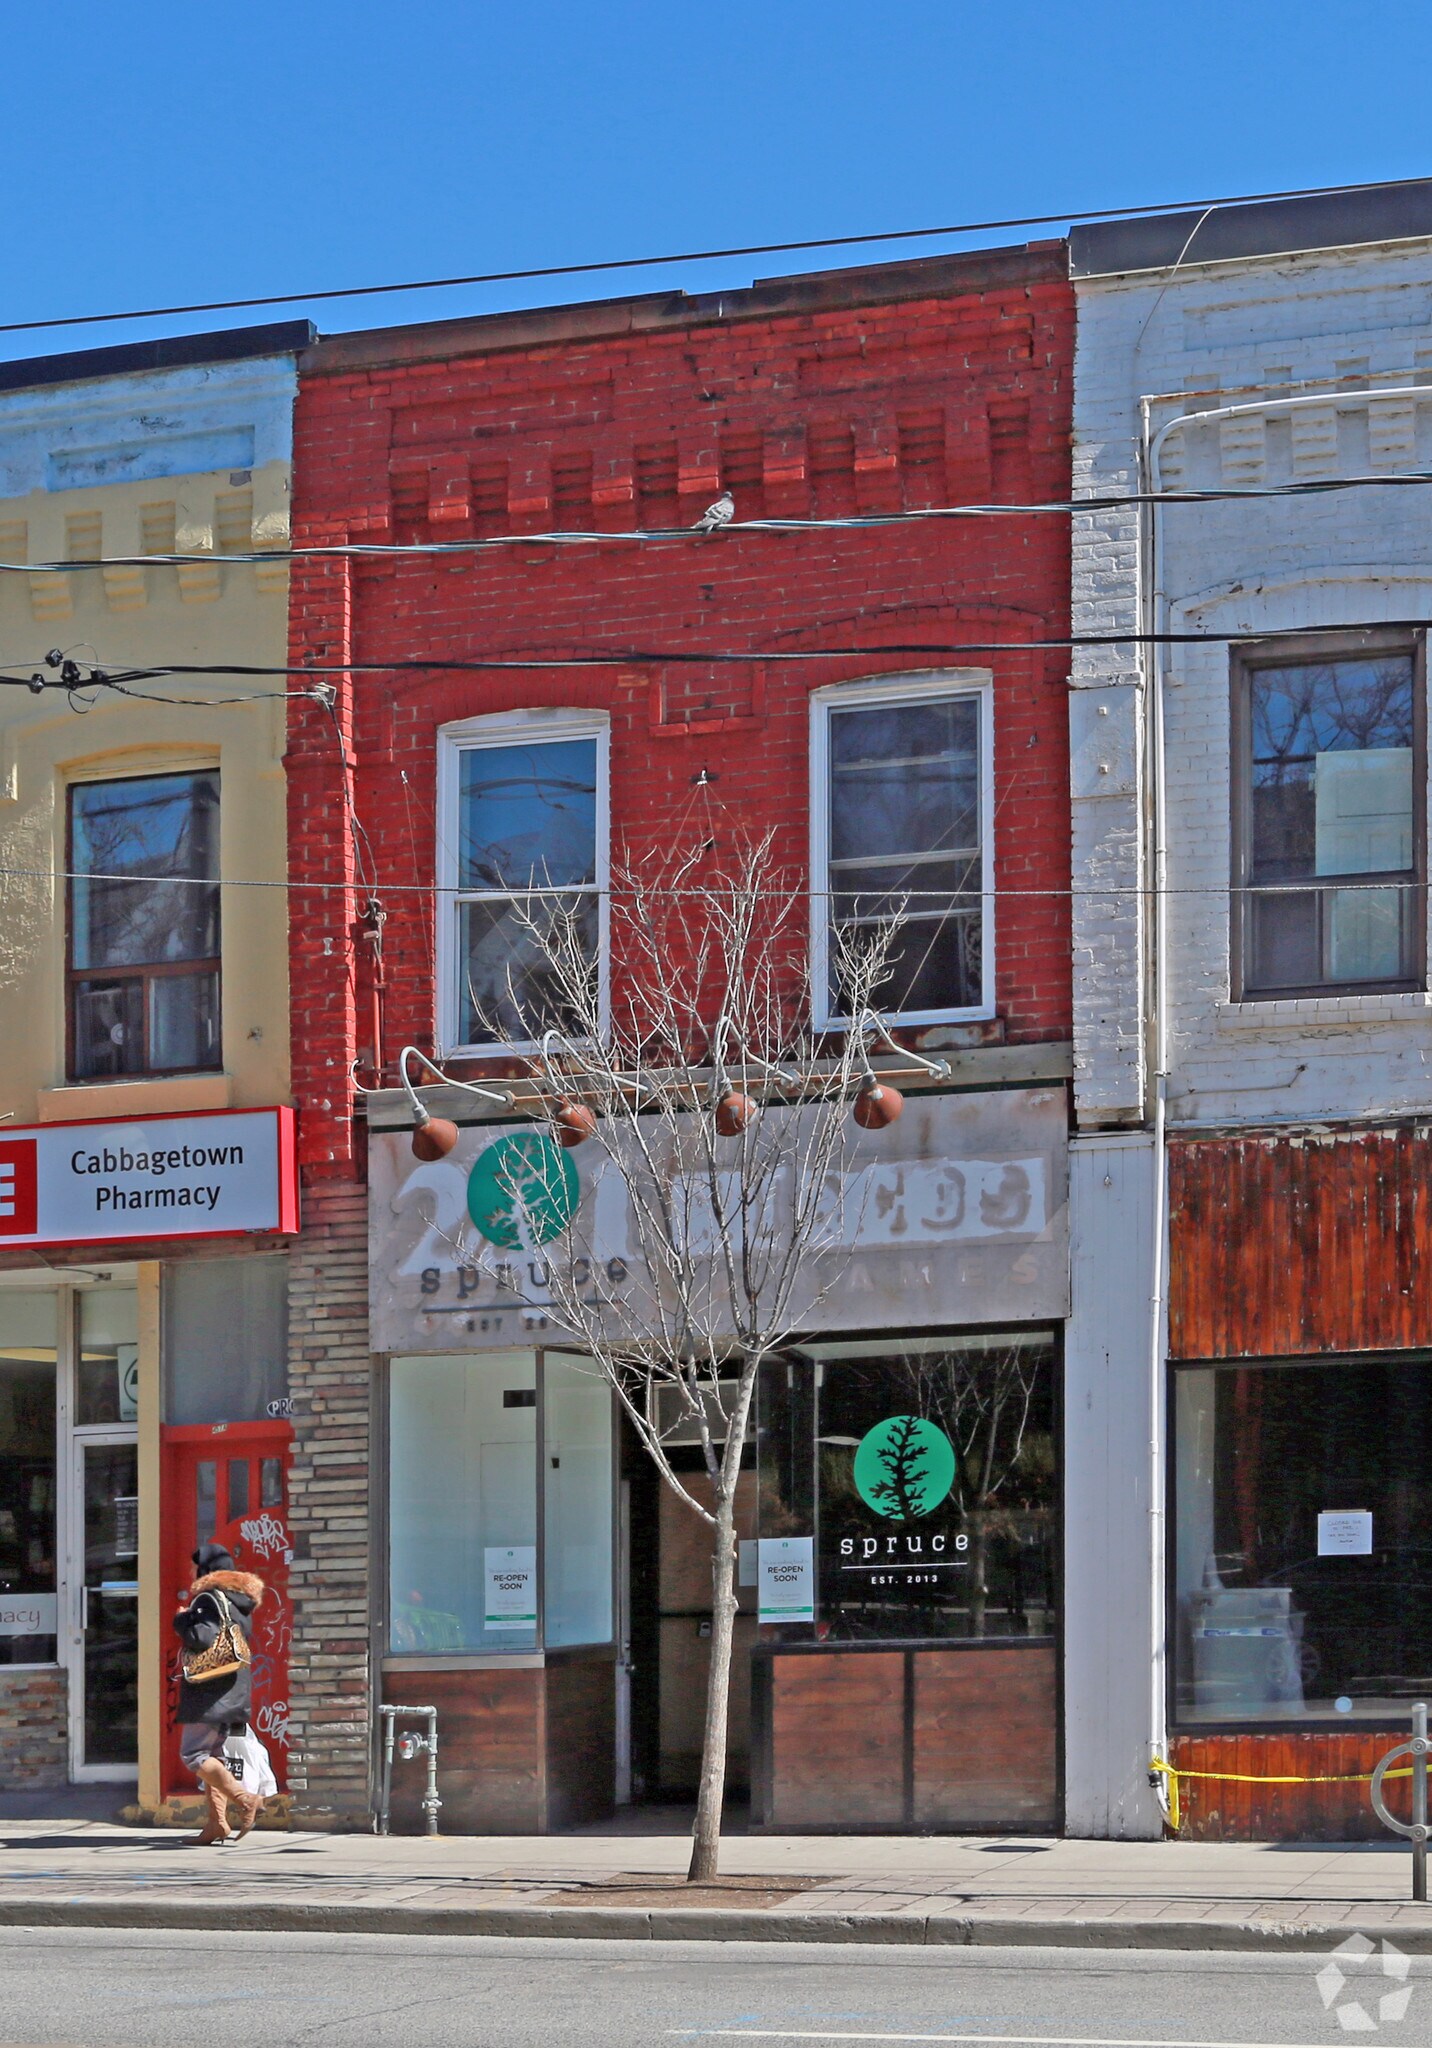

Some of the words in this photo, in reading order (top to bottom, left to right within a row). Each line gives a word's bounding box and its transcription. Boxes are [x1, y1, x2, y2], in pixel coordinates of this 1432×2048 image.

[71, 1145, 243, 1175] Cabbagetown
[96, 1185, 221, 1211] Pharmacy
[421, 1257, 628, 1299] spruce
[841, 1534, 968, 1558] spruce
[871, 1576, 898, 1584] EST.
[907, 1575, 938, 1583] 2013
